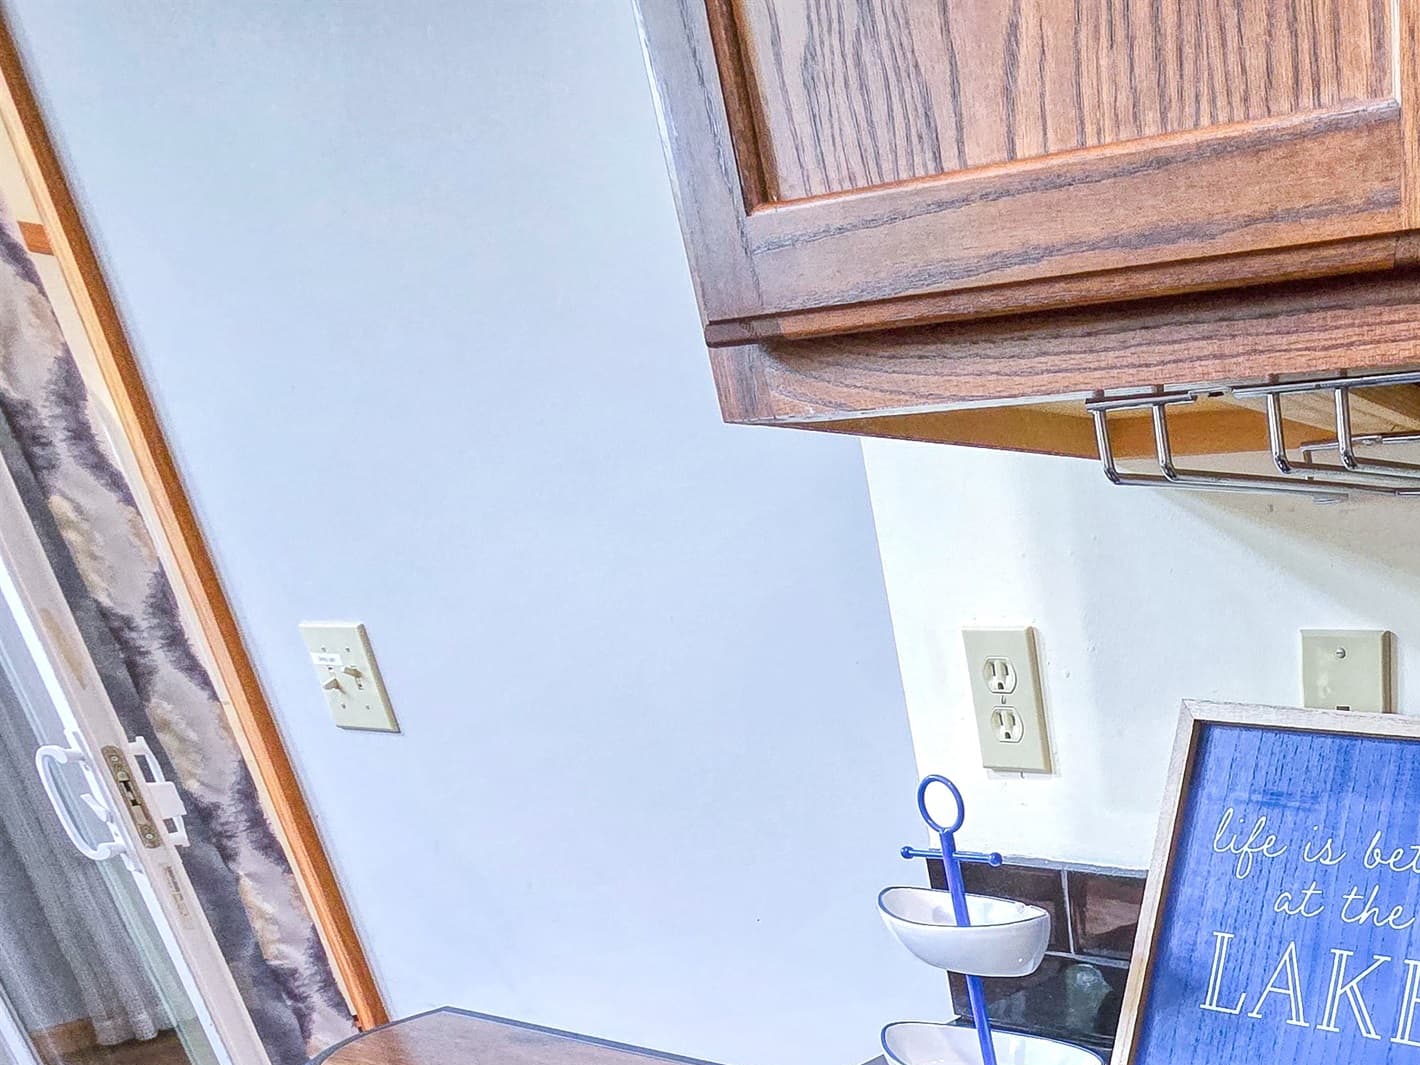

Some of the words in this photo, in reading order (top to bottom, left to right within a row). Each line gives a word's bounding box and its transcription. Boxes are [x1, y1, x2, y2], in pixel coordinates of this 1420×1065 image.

[1212, 808, 1287, 881] life
[1303, 826, 1346, 866] is
[1274, 882, 1325, 918] at
[1340, 885, 1416, 930] the
